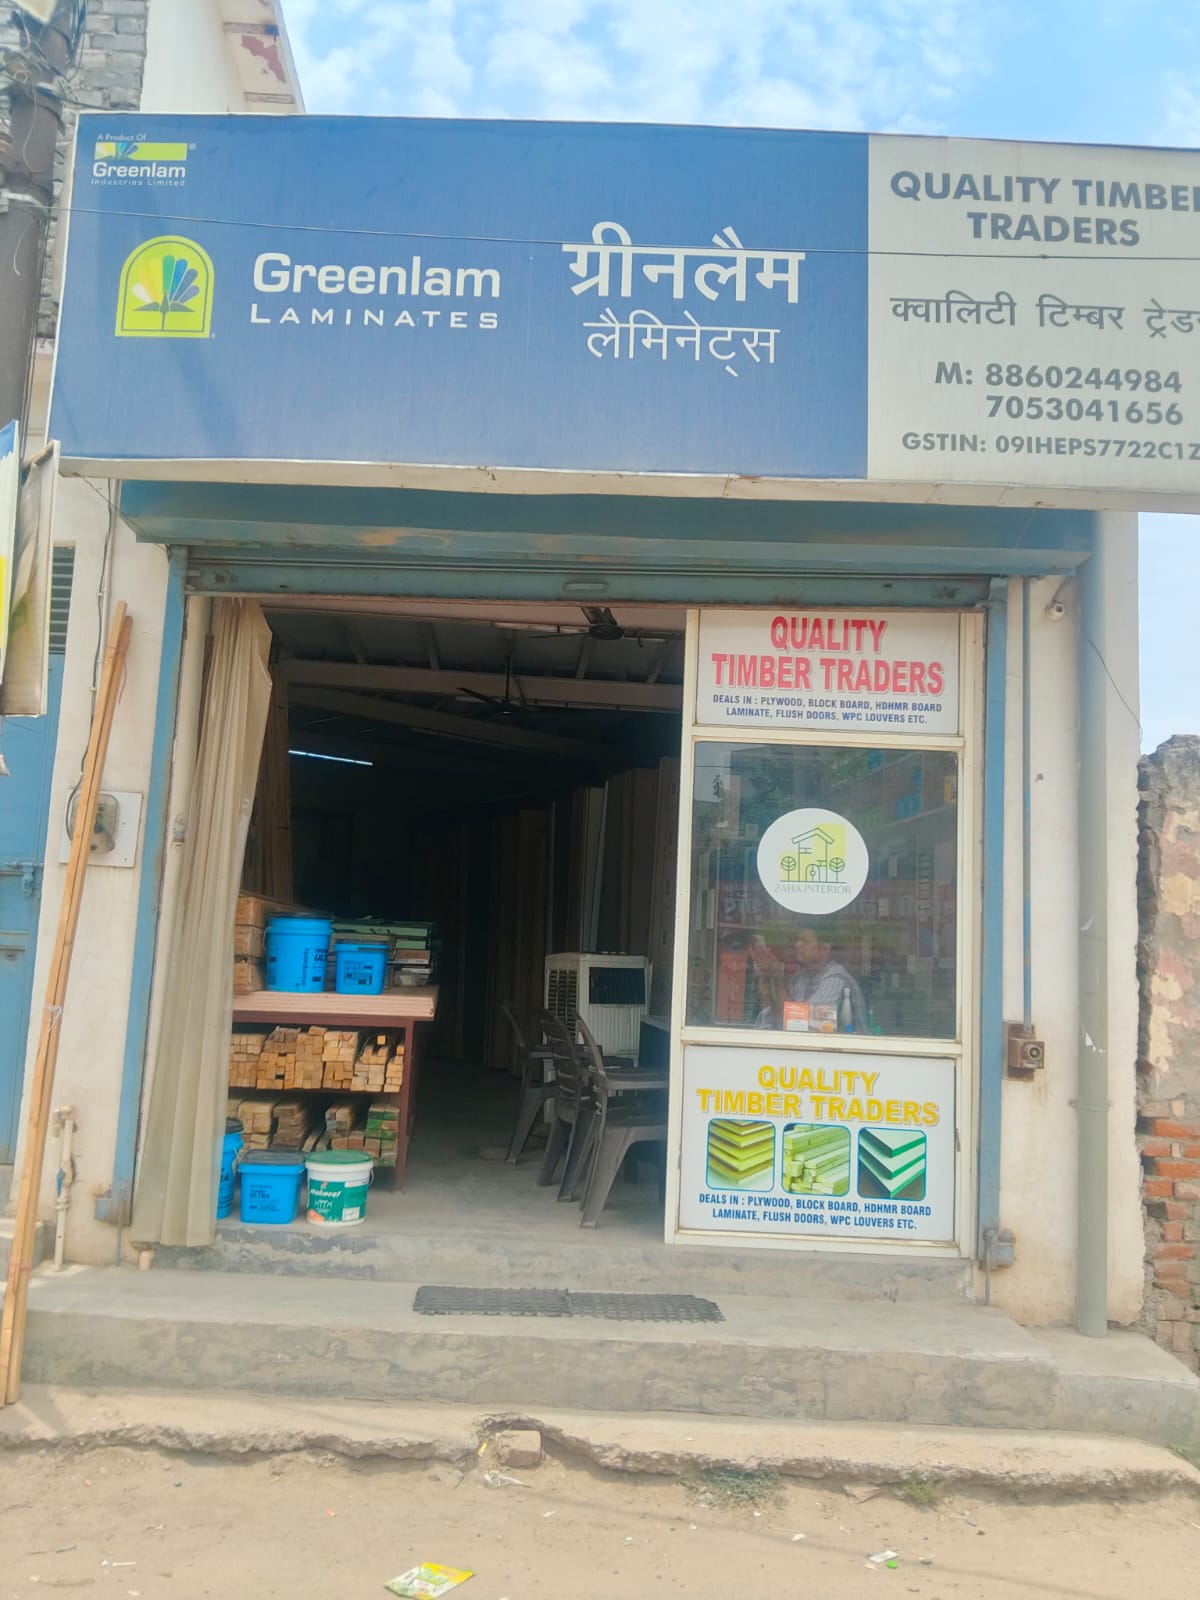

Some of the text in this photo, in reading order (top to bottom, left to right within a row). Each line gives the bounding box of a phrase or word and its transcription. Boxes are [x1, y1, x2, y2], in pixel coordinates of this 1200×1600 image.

[105, 133, 134, 141] Product
[136, 133, 146, 141] Of
[92, 161, 186, 178] Greenlam
[147, 179, 186, 187] Limited
[890, 170, 1061, 204] QUALITY
[967, 211, 1140, 247] TRADERS
[253, 252, 501, 298] Greenlam
[562, 221, 806, 304] ग्रीनलैम
[250, 303, 499, 329] LAMINATES
[889, 290, 1200, 339] क्वालिटी टिम्बर ट्रेड
[582, 307, 780, 378] लैमिनेट्स
[935, 361, 1182, 394] M: 8860244984
[986, 395, 1184, 426] 7053041656
[902, 432, 986, 452] GSTIN:
[770, 616, 888, 653] QUALITY
[711, 653, 944, 696] TIMBER TRADERS
[713, 694, 740, 704] DEALS
[742, 695, 752, 705] IN
[761, 696, 806, 708] PLYWOOD,
[808, 698, 837, 708] BLOCK
[840, 700, 873, 710] BOARD,
[875, 701, 909, 712] HDHMR
[911, 702, 942, 712] BOARD
[726, 707, 928, 724] LAMINATE, FLUSH DOORS, WPC LOUVERS ETC.
[804, 884, 852, 895] INTERIOR
[757, 1064, 880, 1096] QUALITY
[696, 1088, 940, 1126] TIMBER TRADERS
[699, 1193, 727, 1205] DEALS
[729, 1195, 739, 1206] IN
[748, 1196, 793, 1210] PLYWOOD,
[796, 1199, 826, 1210] BLOCK
[828, 1201, 862, 1213] BOARD,
[864, 1203, 898, 1214] HDHMR
[901, 1205, 932, 1216] BOARD
[712, 1208, 917, 1230] LAMINATE, FLUSH DOORS, WPC LOUVERS ETC.
